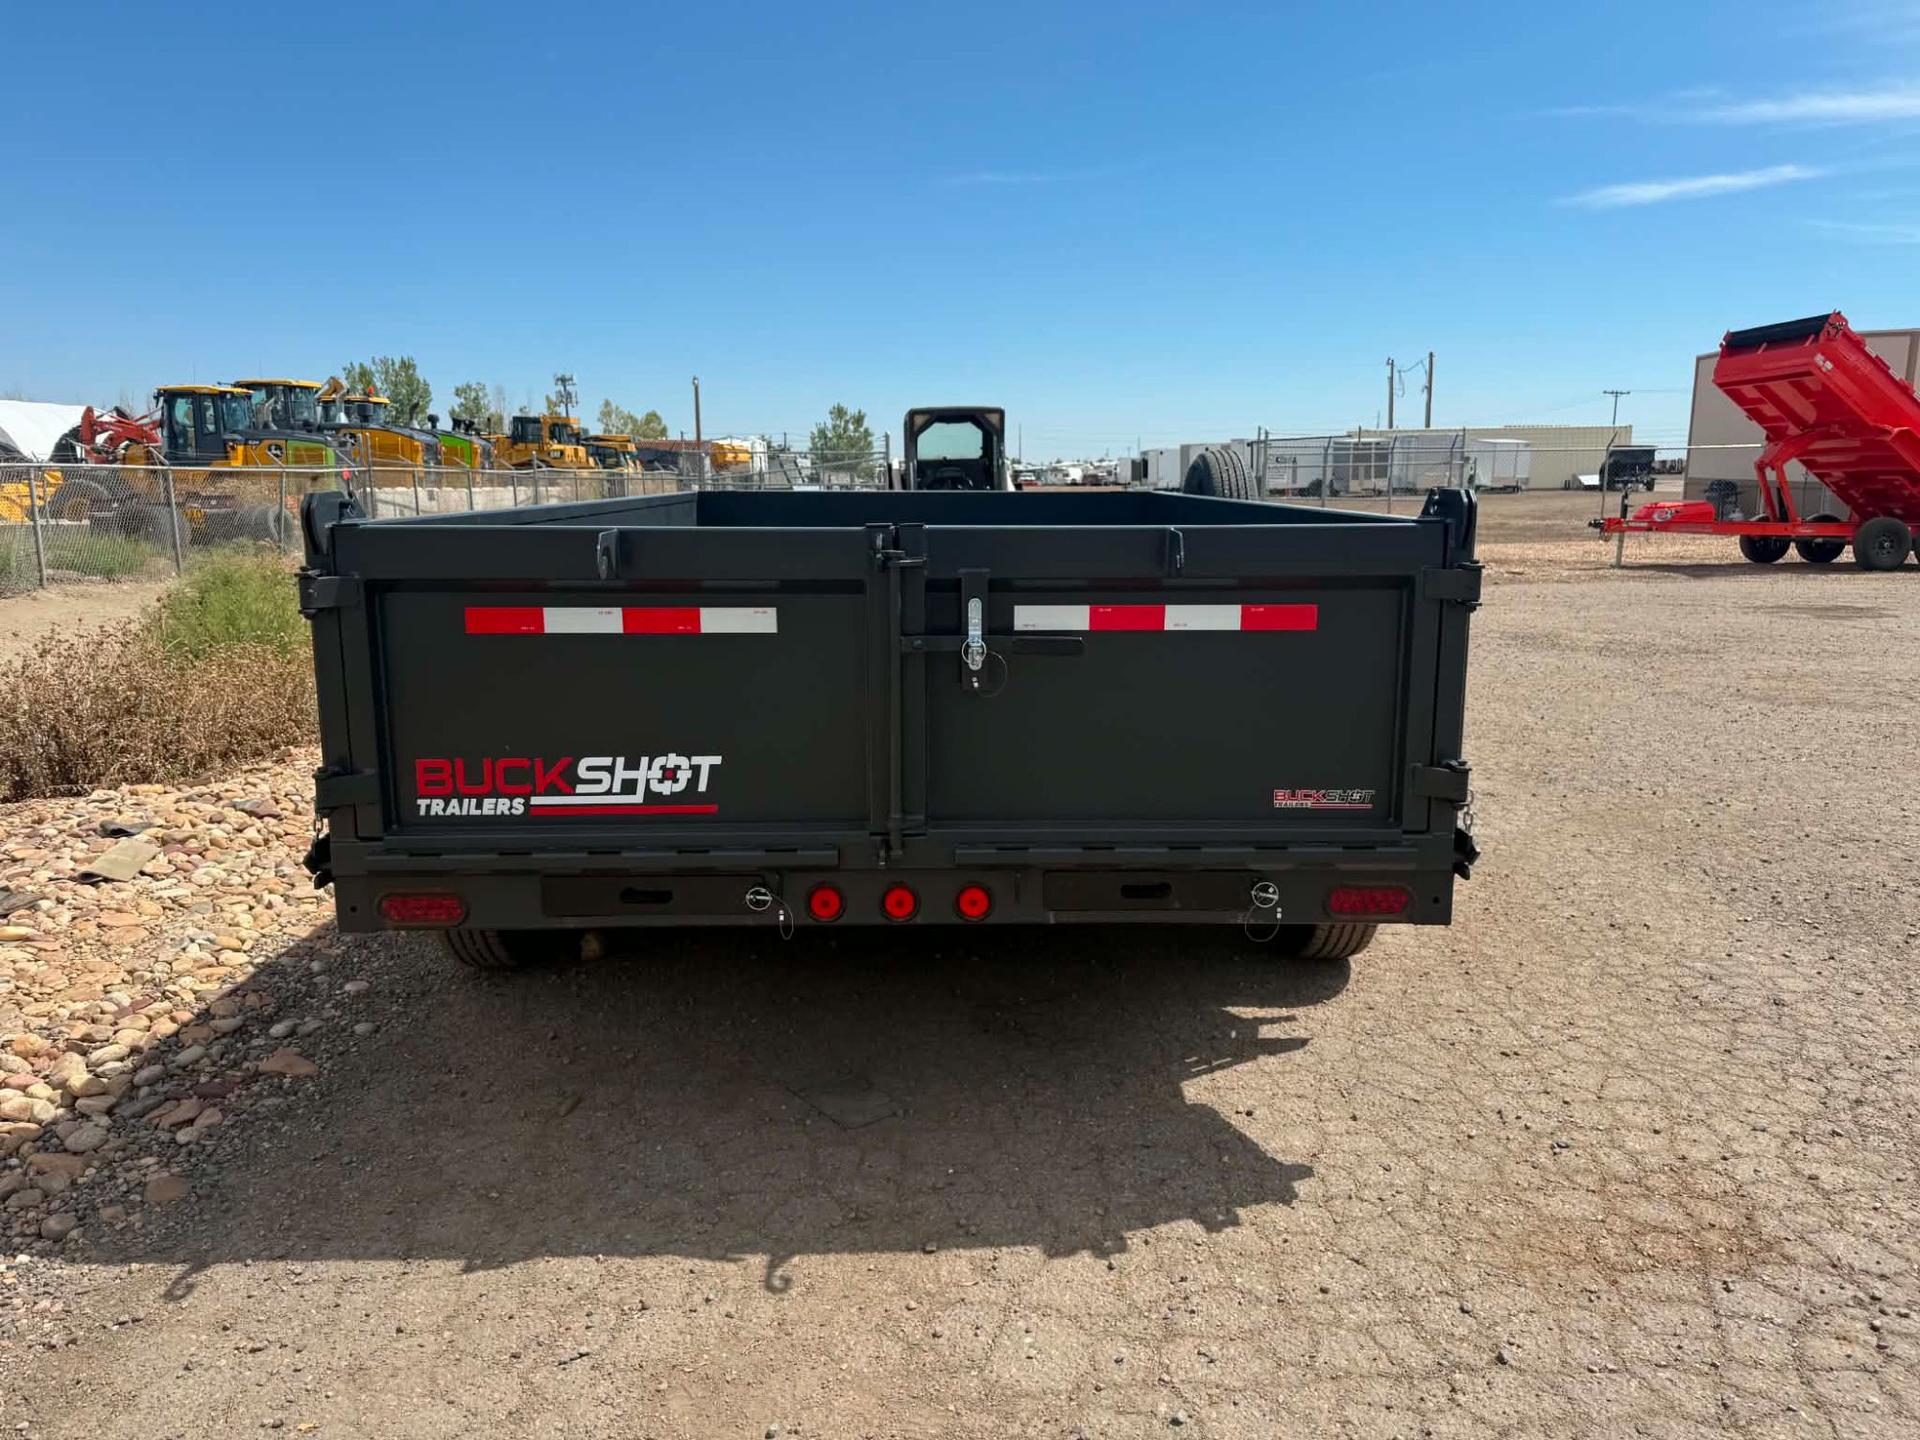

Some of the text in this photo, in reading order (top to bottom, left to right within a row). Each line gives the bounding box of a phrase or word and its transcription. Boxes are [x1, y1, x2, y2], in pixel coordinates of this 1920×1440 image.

[416, 753, 722, 797] BUCKSHOT
[1273, 789, 1375, 803] BUCKSHOT
[417, 798, 525, 816] TRAILERS
